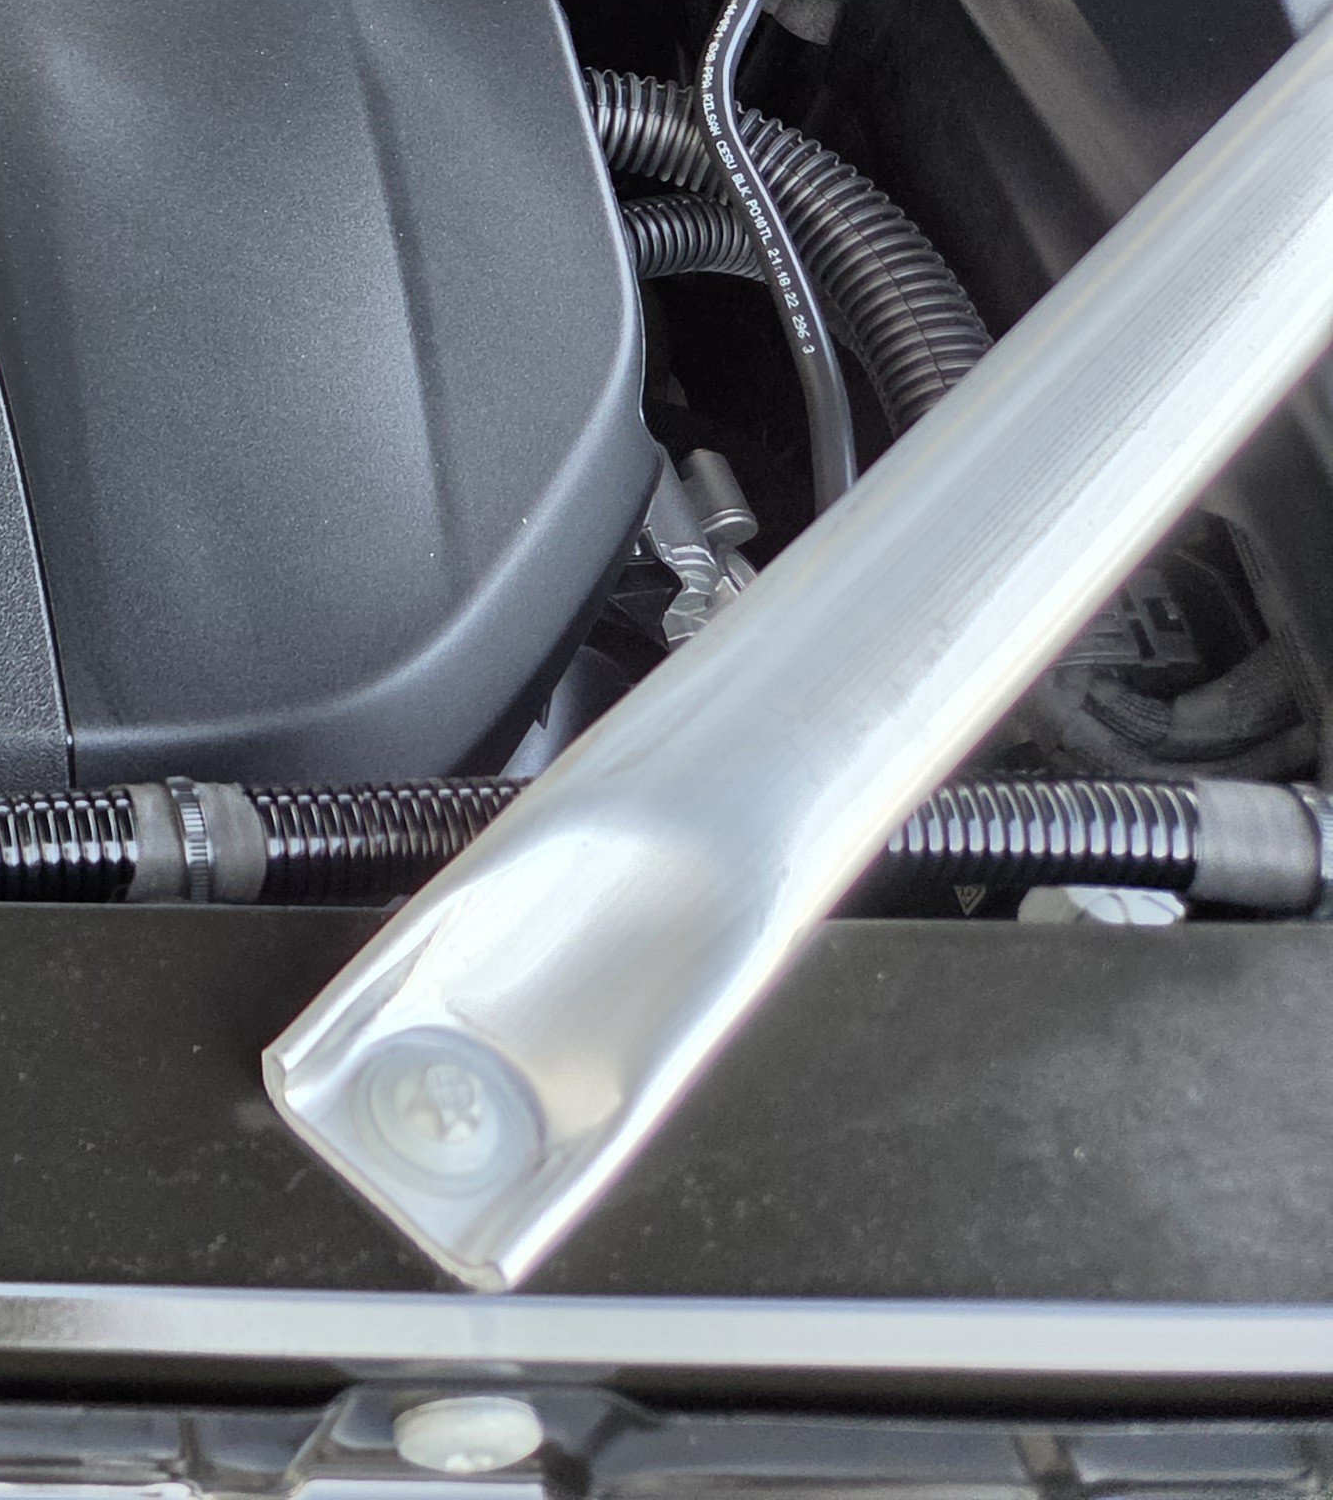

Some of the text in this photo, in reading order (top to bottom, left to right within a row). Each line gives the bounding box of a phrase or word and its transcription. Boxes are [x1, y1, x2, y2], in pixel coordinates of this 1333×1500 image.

[701, 66, 714, 89] PPA
[702, 94, 722, 137] RILSAN
[731, 172, 753, 199] BLK
[767, 248, 800, 309] 21:18:22
[792, 313, 811, 340] 296
[802, 344, 816, 355] 3
